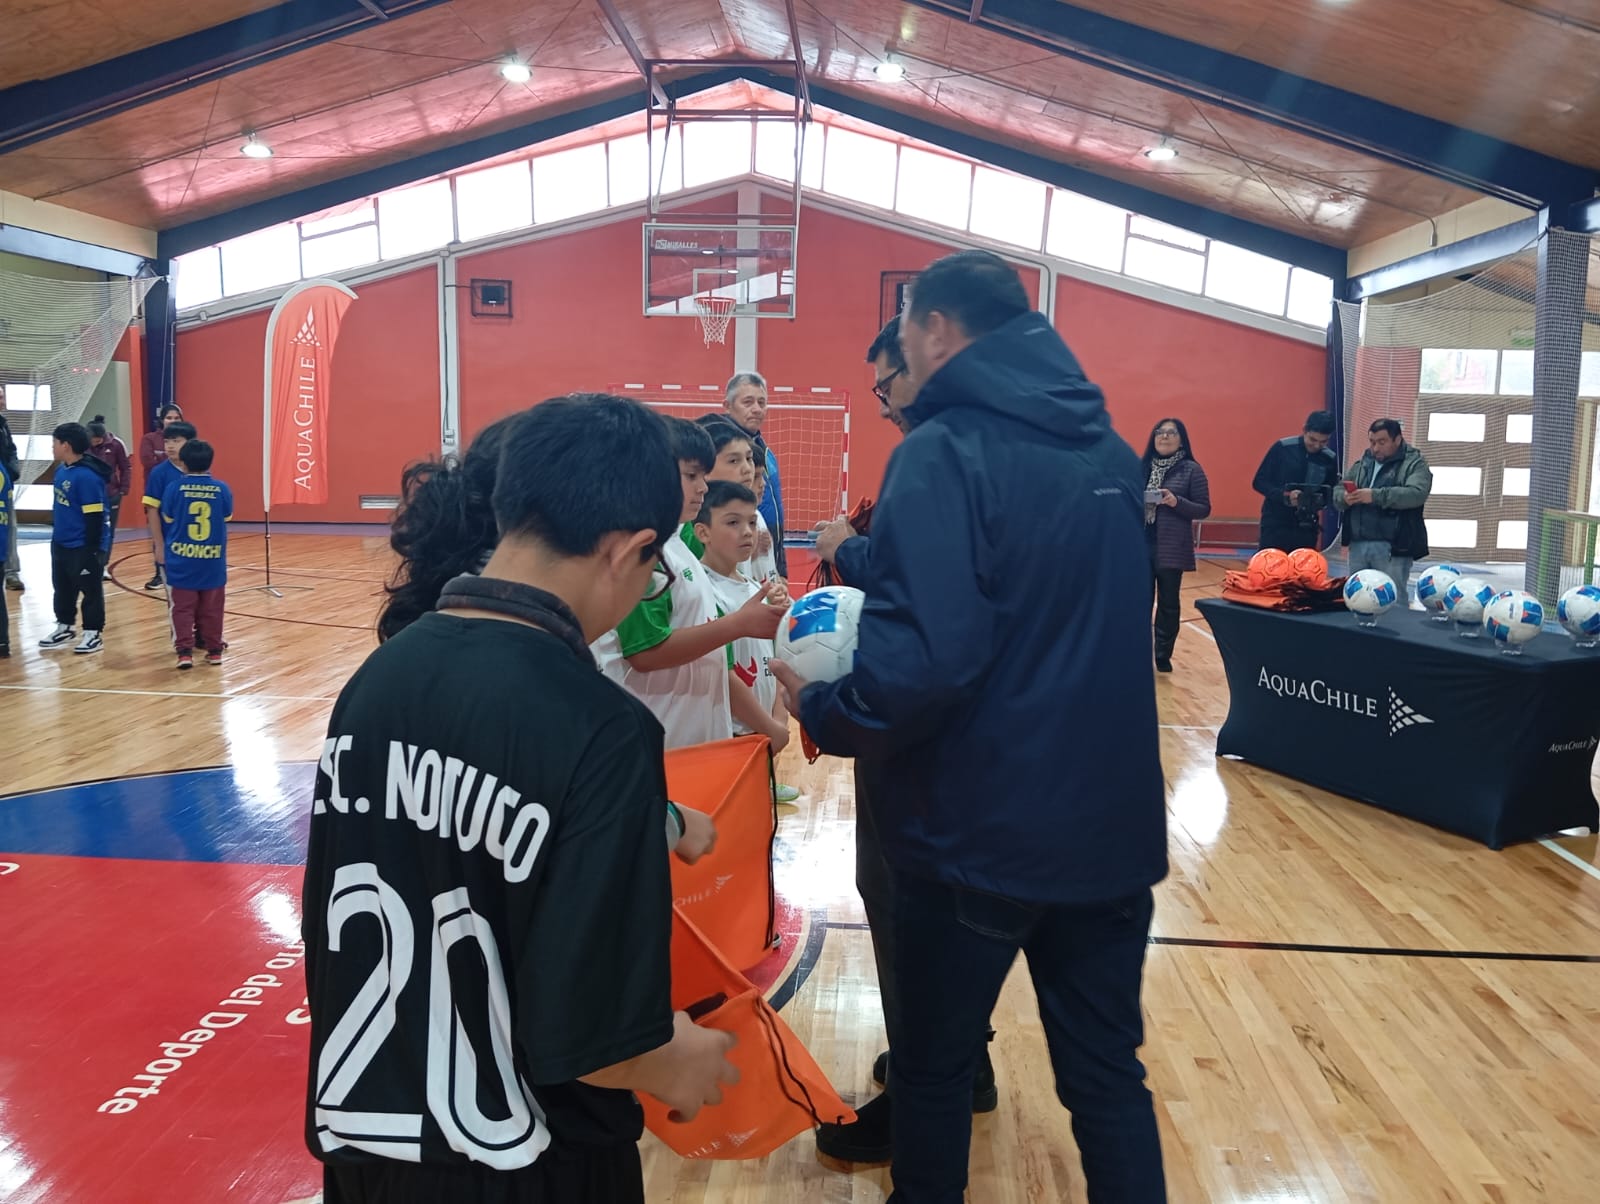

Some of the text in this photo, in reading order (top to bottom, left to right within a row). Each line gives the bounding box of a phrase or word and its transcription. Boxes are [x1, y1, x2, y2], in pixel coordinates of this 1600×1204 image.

[171, 542, 222, 559] CHONCHI
[187, 501, 212, 541] 3
[385, 740, 550, 883] NOTUCO
[218, 973, 284, 1006] del
[315, 862, 552, 1171] 20
[96, 1011, 249, 1115] Deporte
